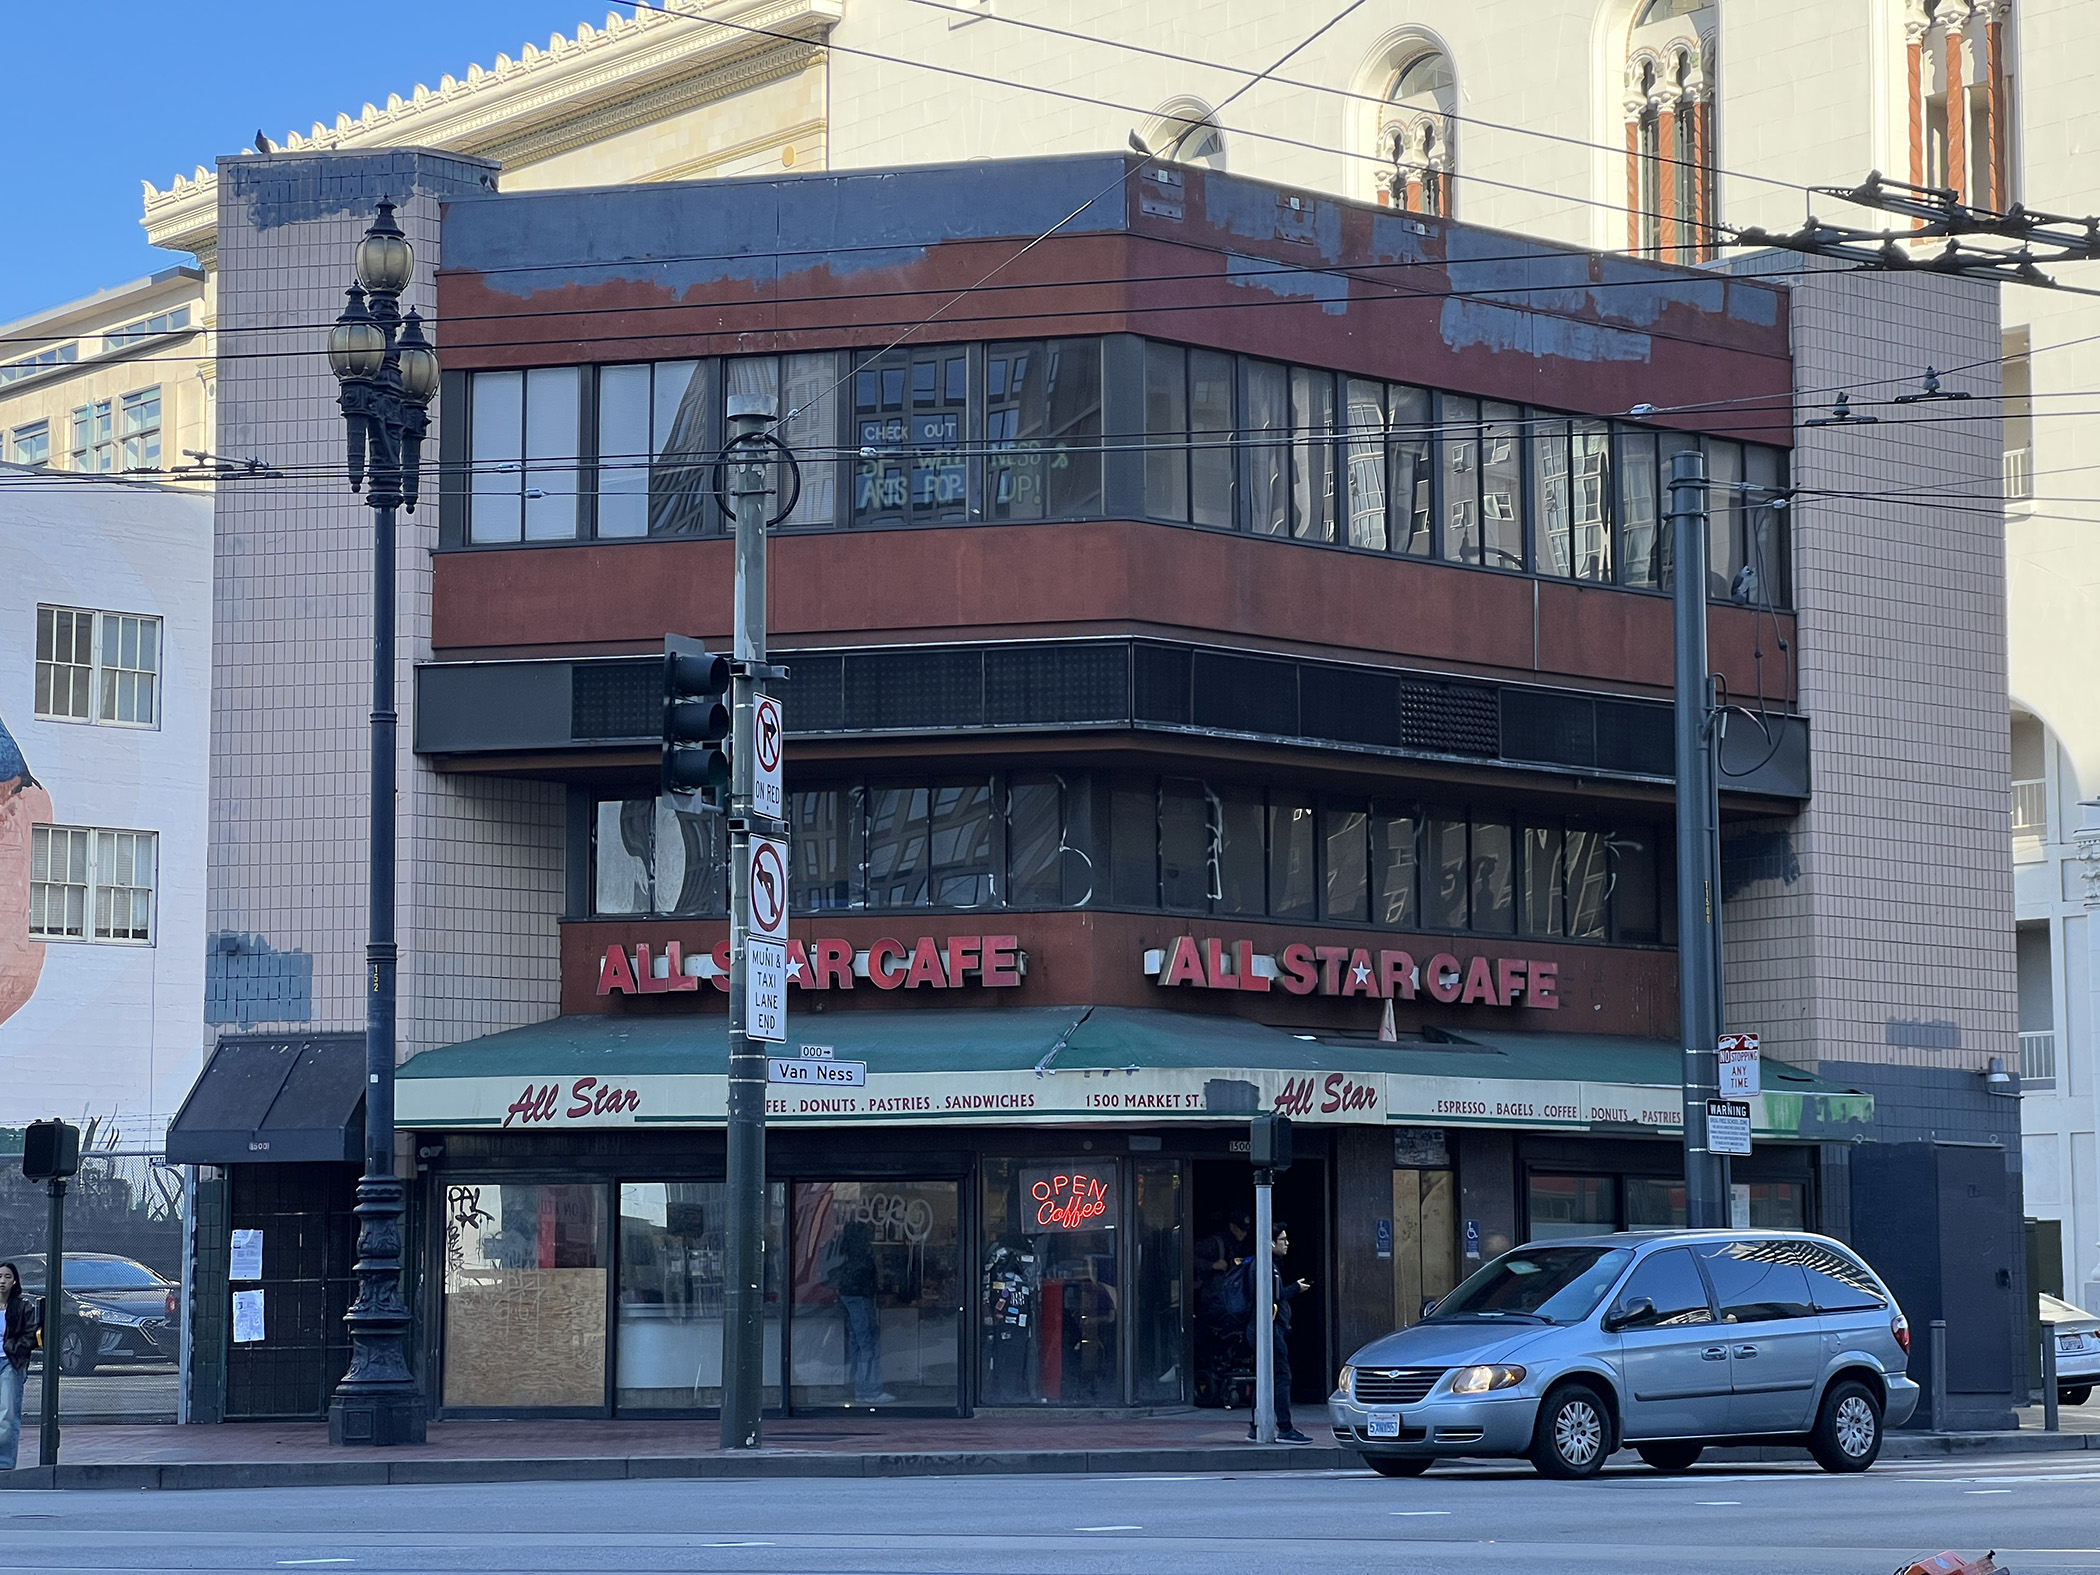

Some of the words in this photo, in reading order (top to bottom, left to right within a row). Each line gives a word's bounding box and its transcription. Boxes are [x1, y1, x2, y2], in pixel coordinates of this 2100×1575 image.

[864, 425, 909, 441] CHECK
[924, 422, 957, 438] OUT
[856, 475, 908, 510] ARTS
[755, 780, 765, 800] ON
[767, 784, 780, 805] RED
[596, 940, 698, 996] ALL
[711, 938, 854, 993] SAR
[867, 935, 1020, 990] CAFE
[752, 951, 775, 966] MUNI
[775, 953, 782, 969] &
[757, 971, 776, 987] TAXI
[1163, 935, 1272, 992] ALL
[1281, 943, 1416, 1000] STAR
[1426, 952, 1560, 1009] CAFE
[755, 992, 778, 1009] LANE
[758, 1015, 775, 1030] END
[803, 1046, 822, 1057] 000
[1720, 1050, 1730, 1063] NO
[1731, 1051, 1758, 1063] STOPPING
[779, 1064, 808, 1079] Van
[816, 1065, 853, 1081] Ness
[1732, 1066, 1747, 1076] ANY
[1730, 1078, 1749, 1088] TIME
[502, 1083, 559, 1128] All
[566, 1076, 641, 1119] Star
[1085, 1094, 1120, 1108] 1500
[1124, 1093, 1181, 1108] MARKET
[1274, 1076, 1315, 1116] All
[1320, 1072, 1378, 1113] Star
[800, 1098, 856, 1113] DONUTS
[869, 1096, 931, 1111] PASTRIES
[945, 1094, 1036, 1110] SANDWICHES
[1438, 1100, 1487, 1115] ESPRESSO
[1496, 1102, 1533, 1117] BAGELS
[1544, 1104, 1578, 1119] COFFEE
[1591, 1106, 1629, 1122] DONUTS
[1642, 1109, 1681, 1124] PASTRIES
[1709, 1104, 1747, 1117] WARNING
[1031, 1174, 1109, 1201] OPEN
[1037, 1196, 1106, 1229] Coffee
